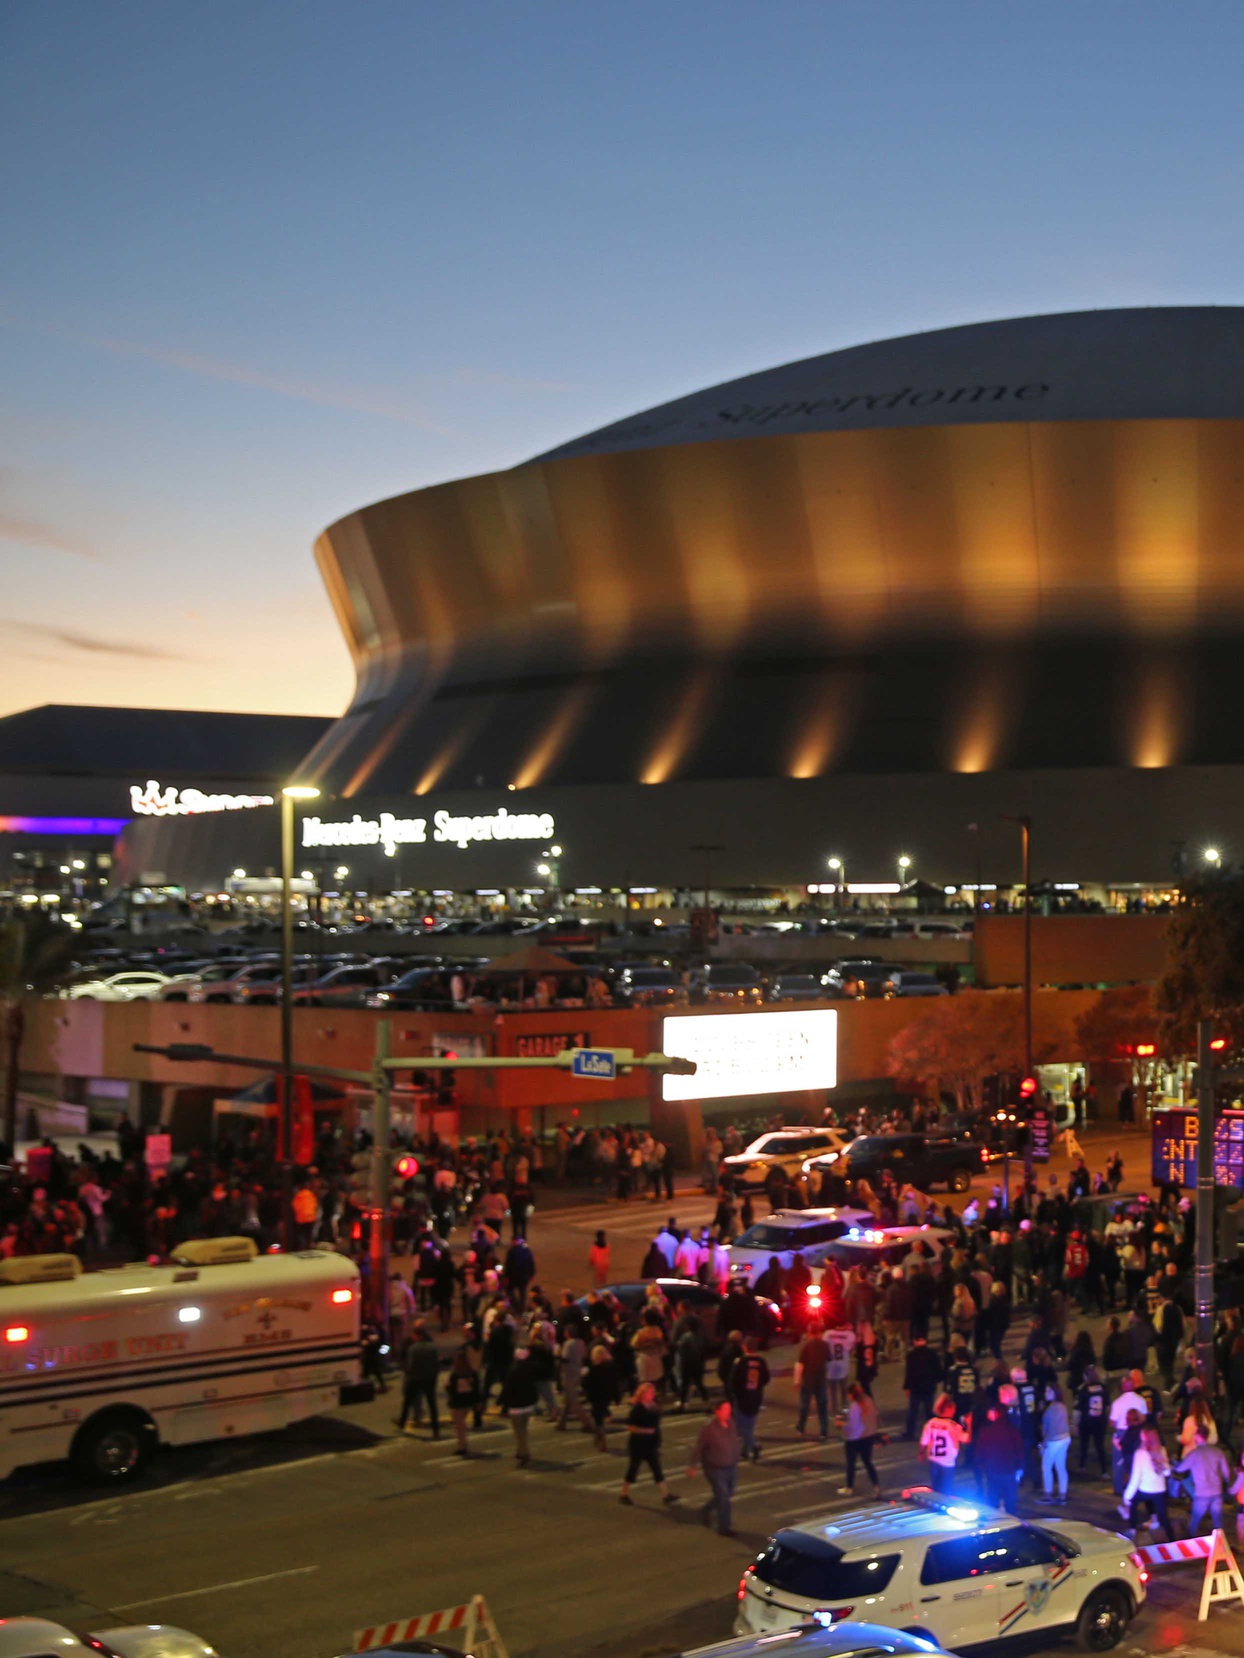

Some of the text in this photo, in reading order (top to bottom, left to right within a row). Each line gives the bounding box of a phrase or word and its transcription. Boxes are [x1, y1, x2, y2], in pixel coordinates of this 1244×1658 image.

[717, 383, 1049, 426] Superdome
[433, 807, 555, 849] Superdome
[518, 1034, 568, 1058] GARAGE
[26, 1339, 119, 1371] SURGE
[125, 1332, 190, 1356] UNIT
